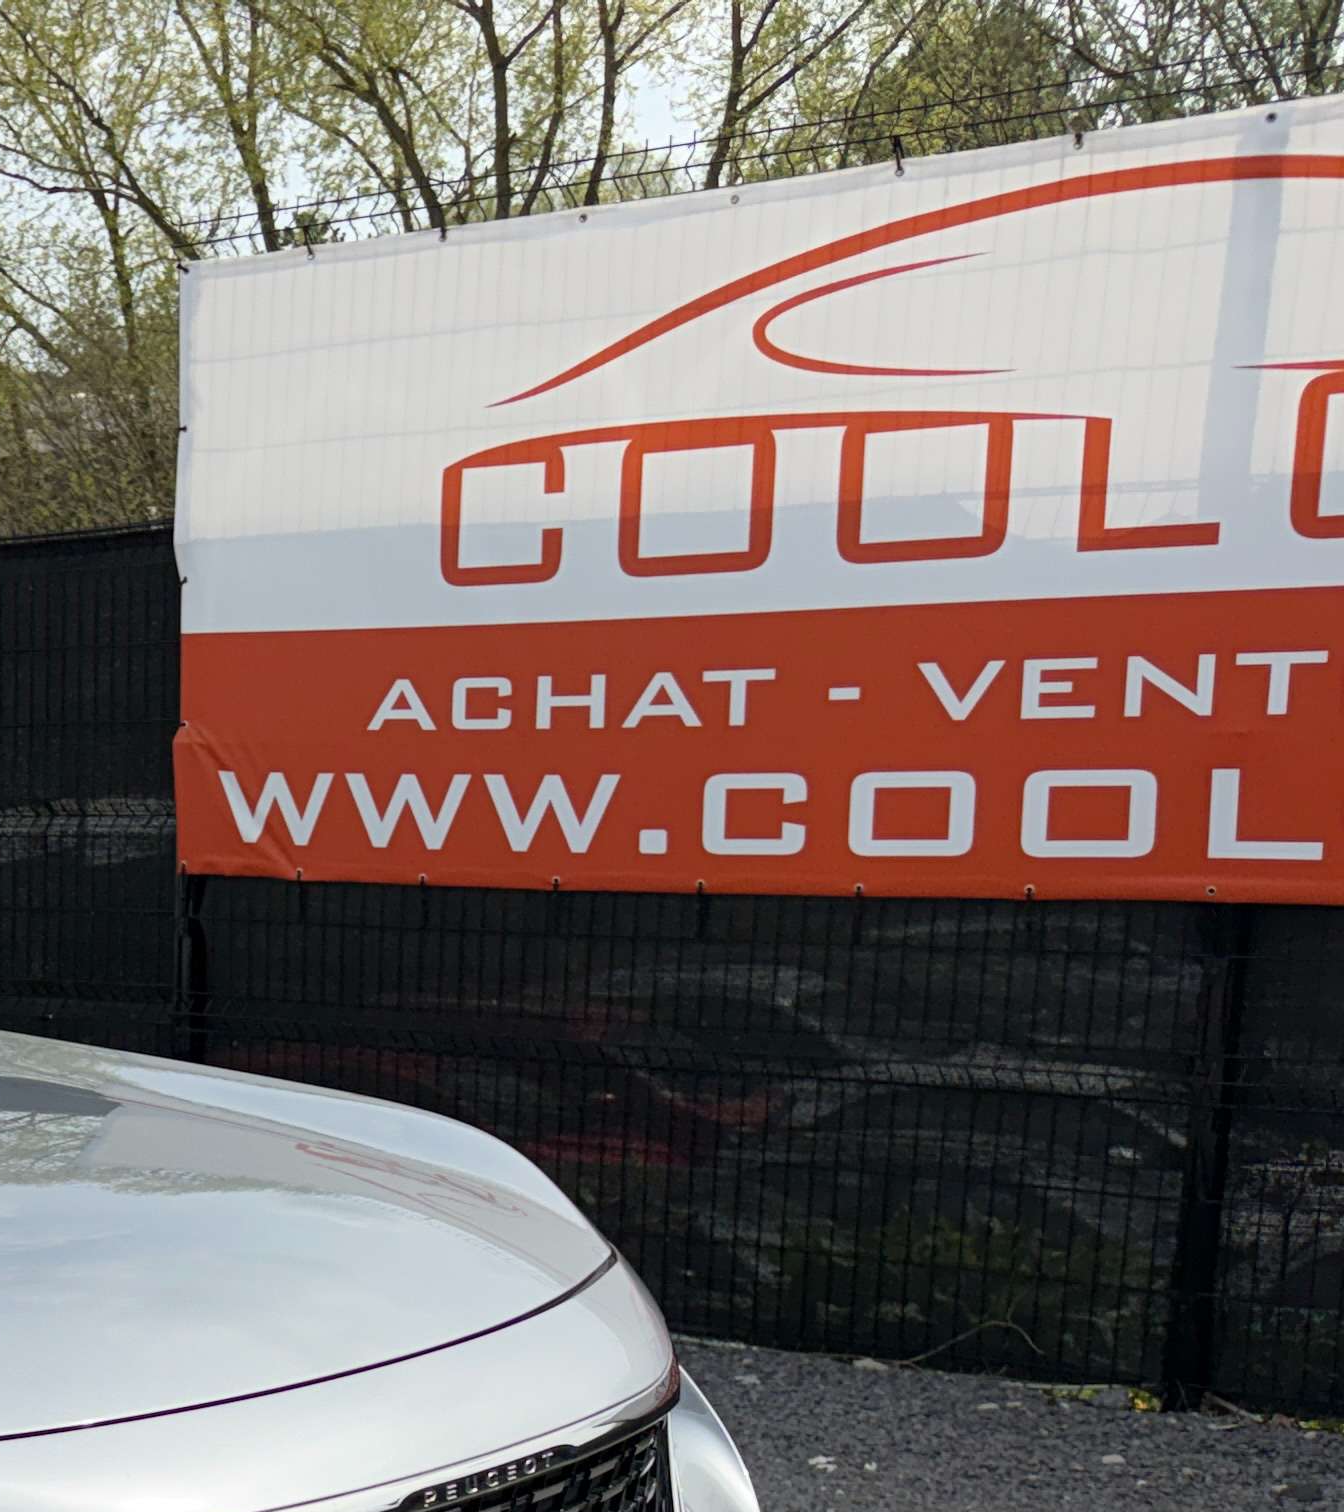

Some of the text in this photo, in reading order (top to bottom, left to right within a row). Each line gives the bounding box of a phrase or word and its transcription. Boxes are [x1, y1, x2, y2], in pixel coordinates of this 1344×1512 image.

[368, 667, 776, 731] ACHAT
[918, 650, 1329, 721] VENT
[218, 767, 1324, 861] WWW.COOL
[423, 1451, 555, 1508] PEUGEOT
